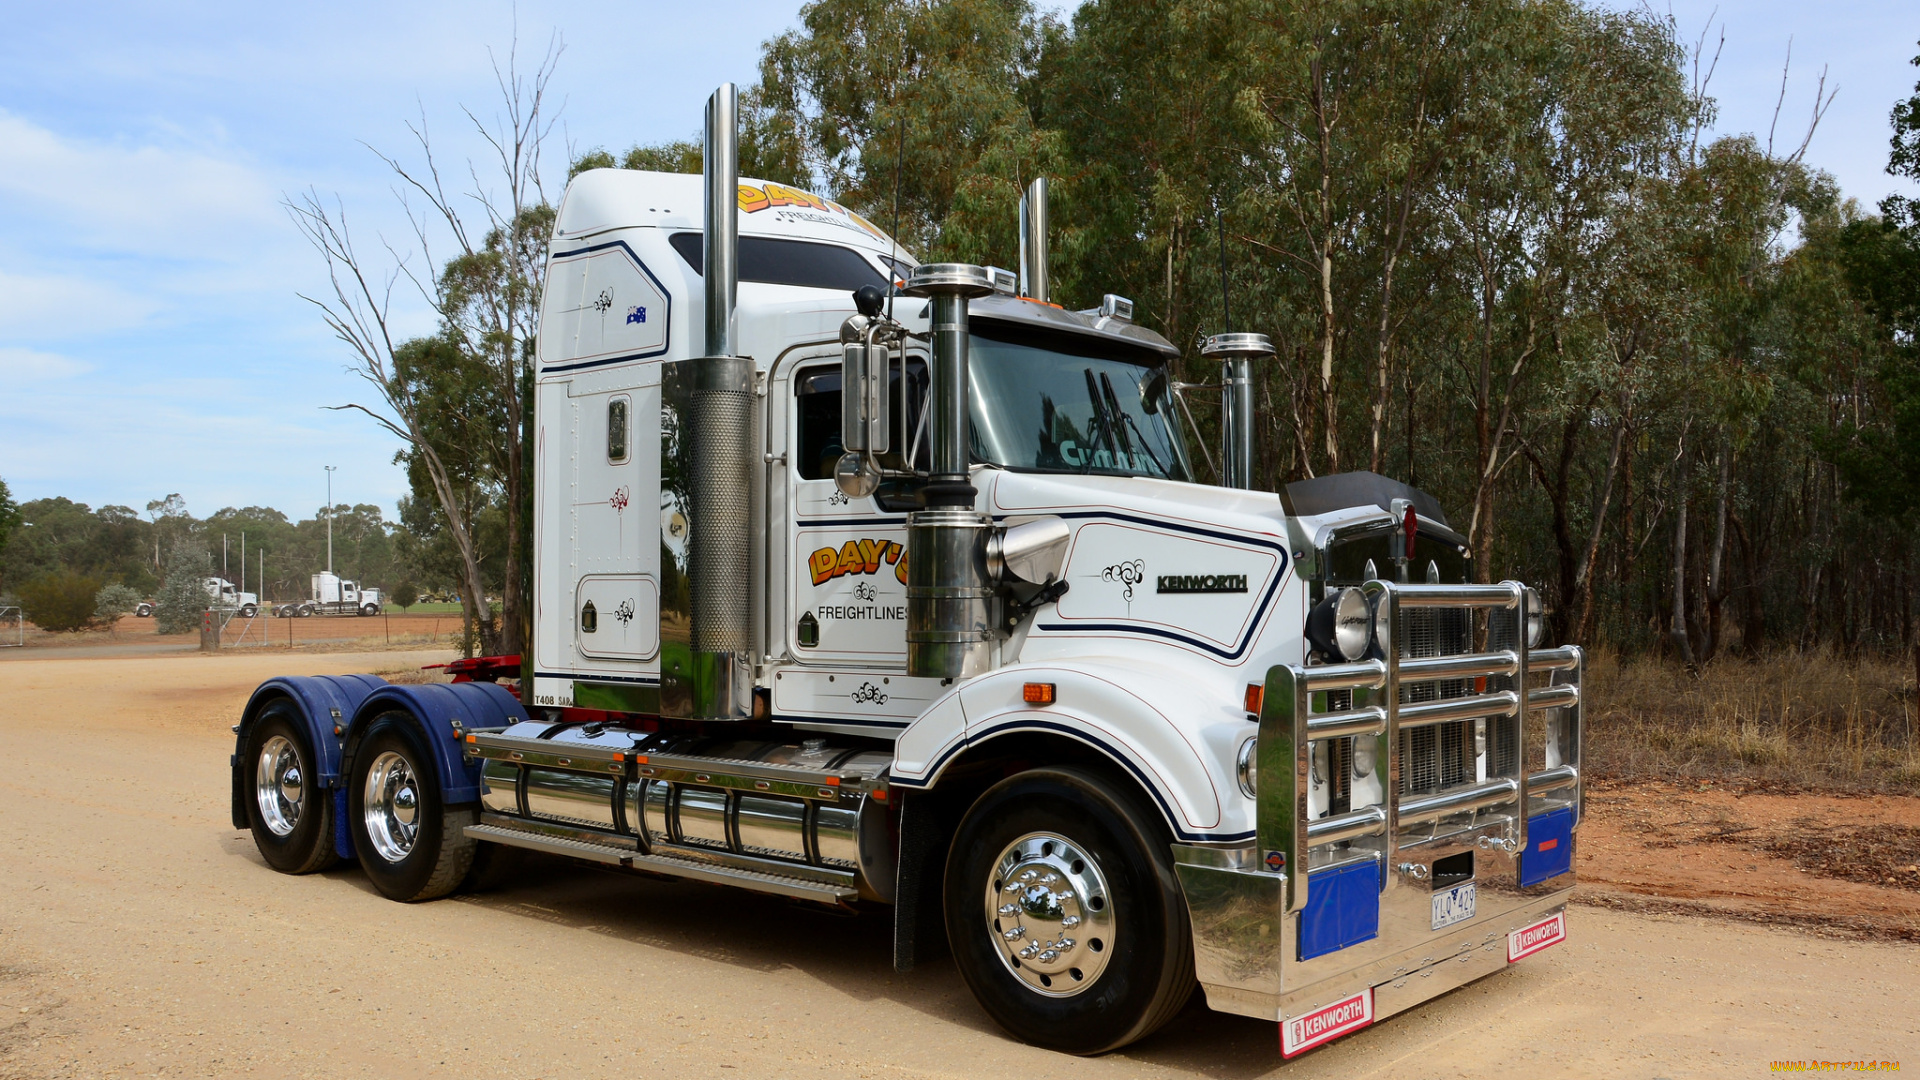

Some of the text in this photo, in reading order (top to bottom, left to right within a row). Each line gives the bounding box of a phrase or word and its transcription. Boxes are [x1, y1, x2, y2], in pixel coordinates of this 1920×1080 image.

[1157, 574, 1248, 590] KENWORTH
[535, 695, 555, 705] T408
[1434, 889, 1474, 920] YLQ 429
[1522, 920, 1559, 947] KENWORTH
[1305, 999, 1363, 1037] KENWORTH
